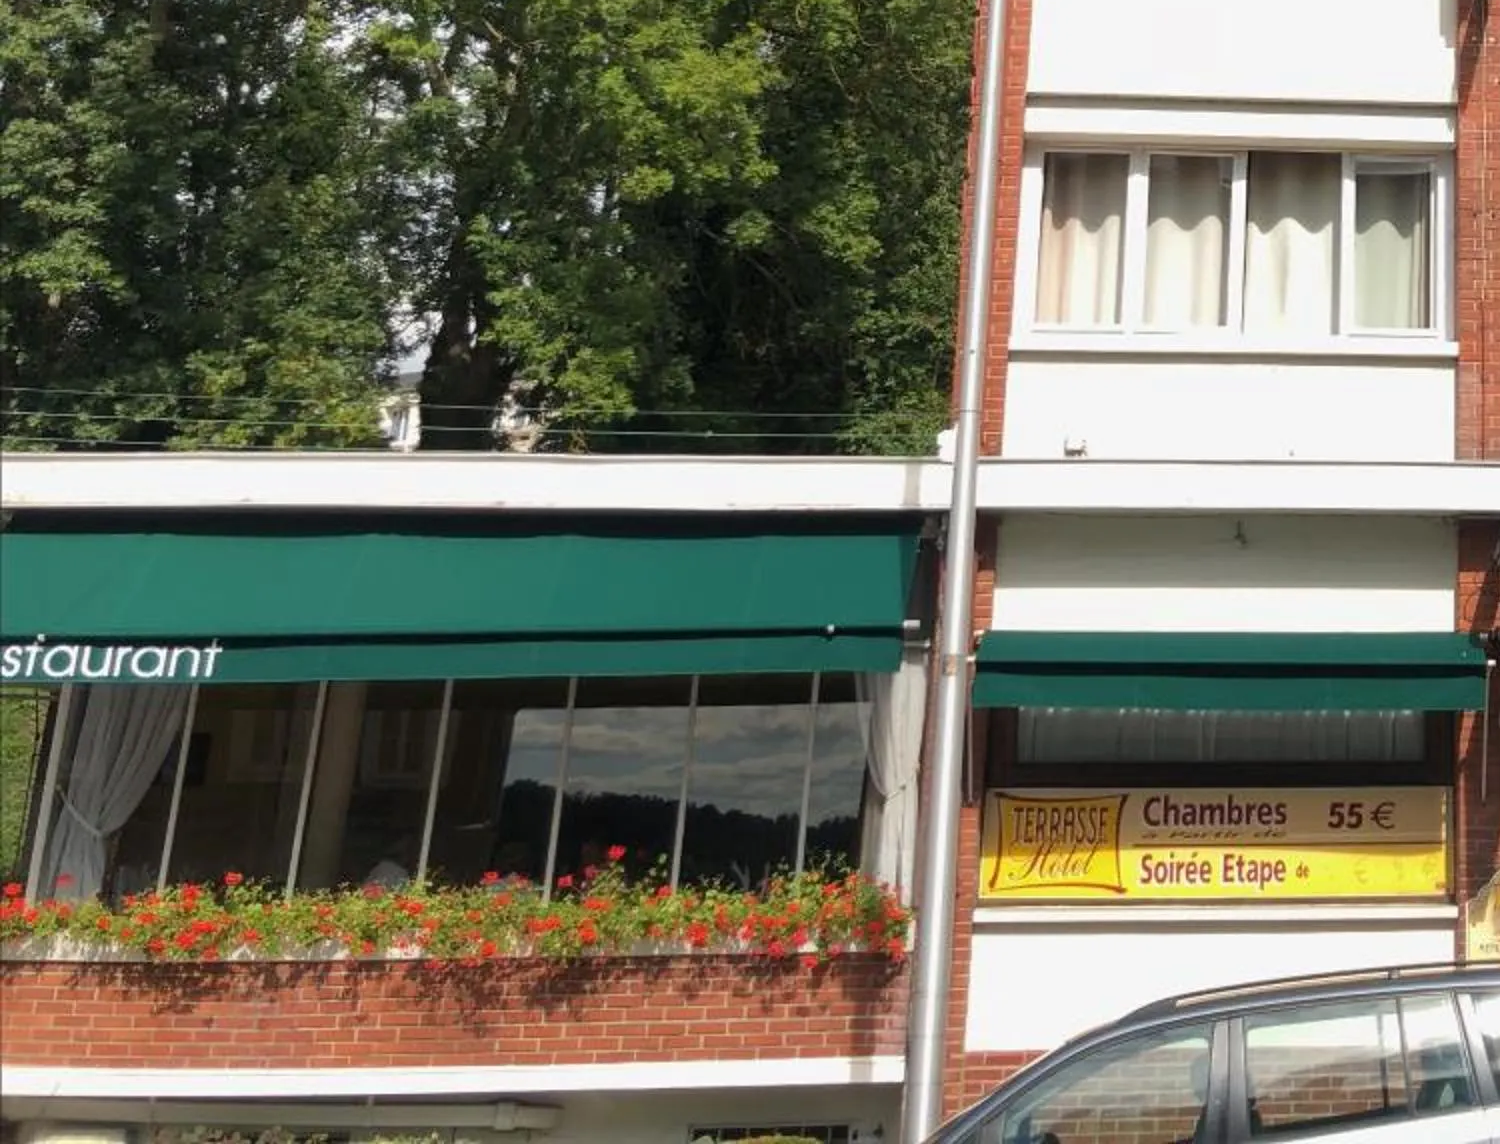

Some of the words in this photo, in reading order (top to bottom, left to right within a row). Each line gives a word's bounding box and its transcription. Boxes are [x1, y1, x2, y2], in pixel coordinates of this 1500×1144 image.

[1012, 806, 1109, 844] TERRASSE
[1142, 794, 1288, 827] Chambres
[1140, 851, 1212, 884] Soirée
[1222, 853, 1287, 890] Etape
[1296, 862, 1310, 879] de
